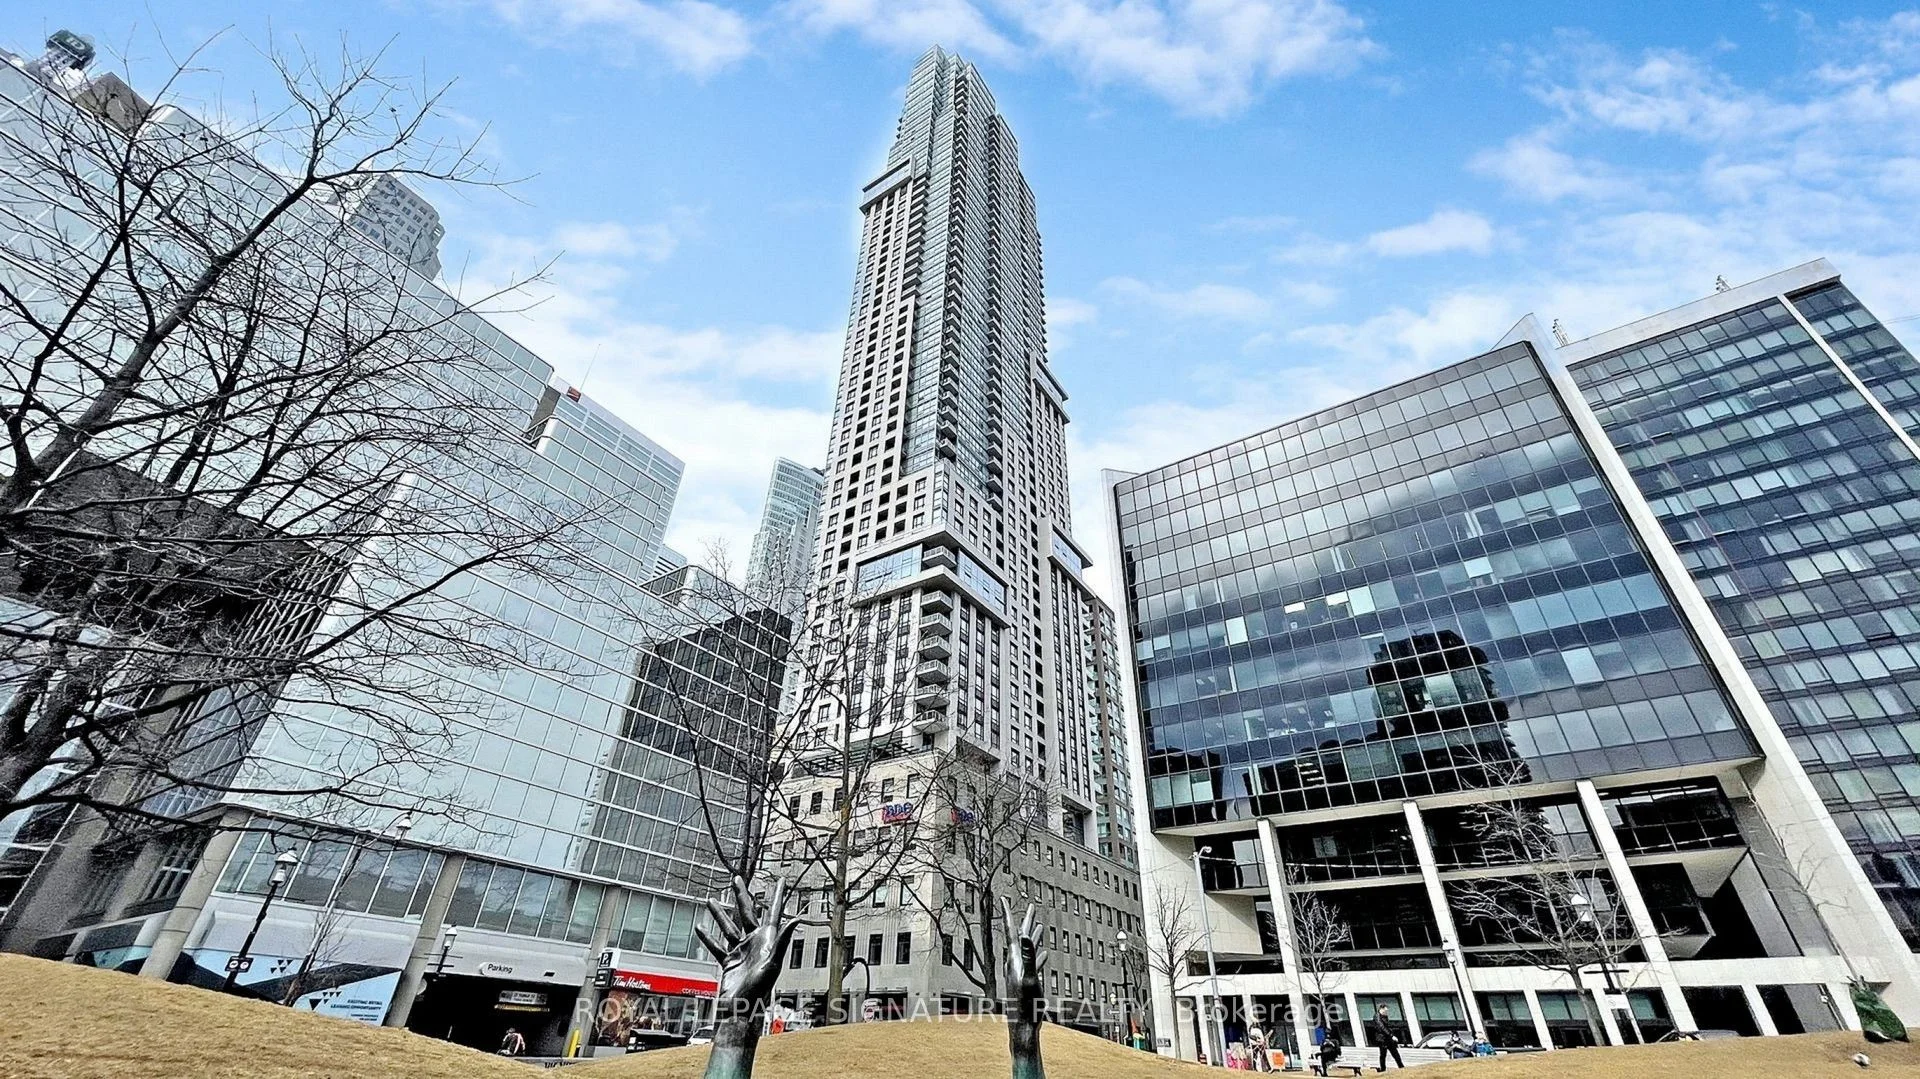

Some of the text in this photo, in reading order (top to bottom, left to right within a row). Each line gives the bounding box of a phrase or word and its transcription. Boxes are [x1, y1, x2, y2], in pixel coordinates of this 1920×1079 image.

[488, 963, 513, 974] Parking
[613, 976, 651, 990] Tim Hortons
